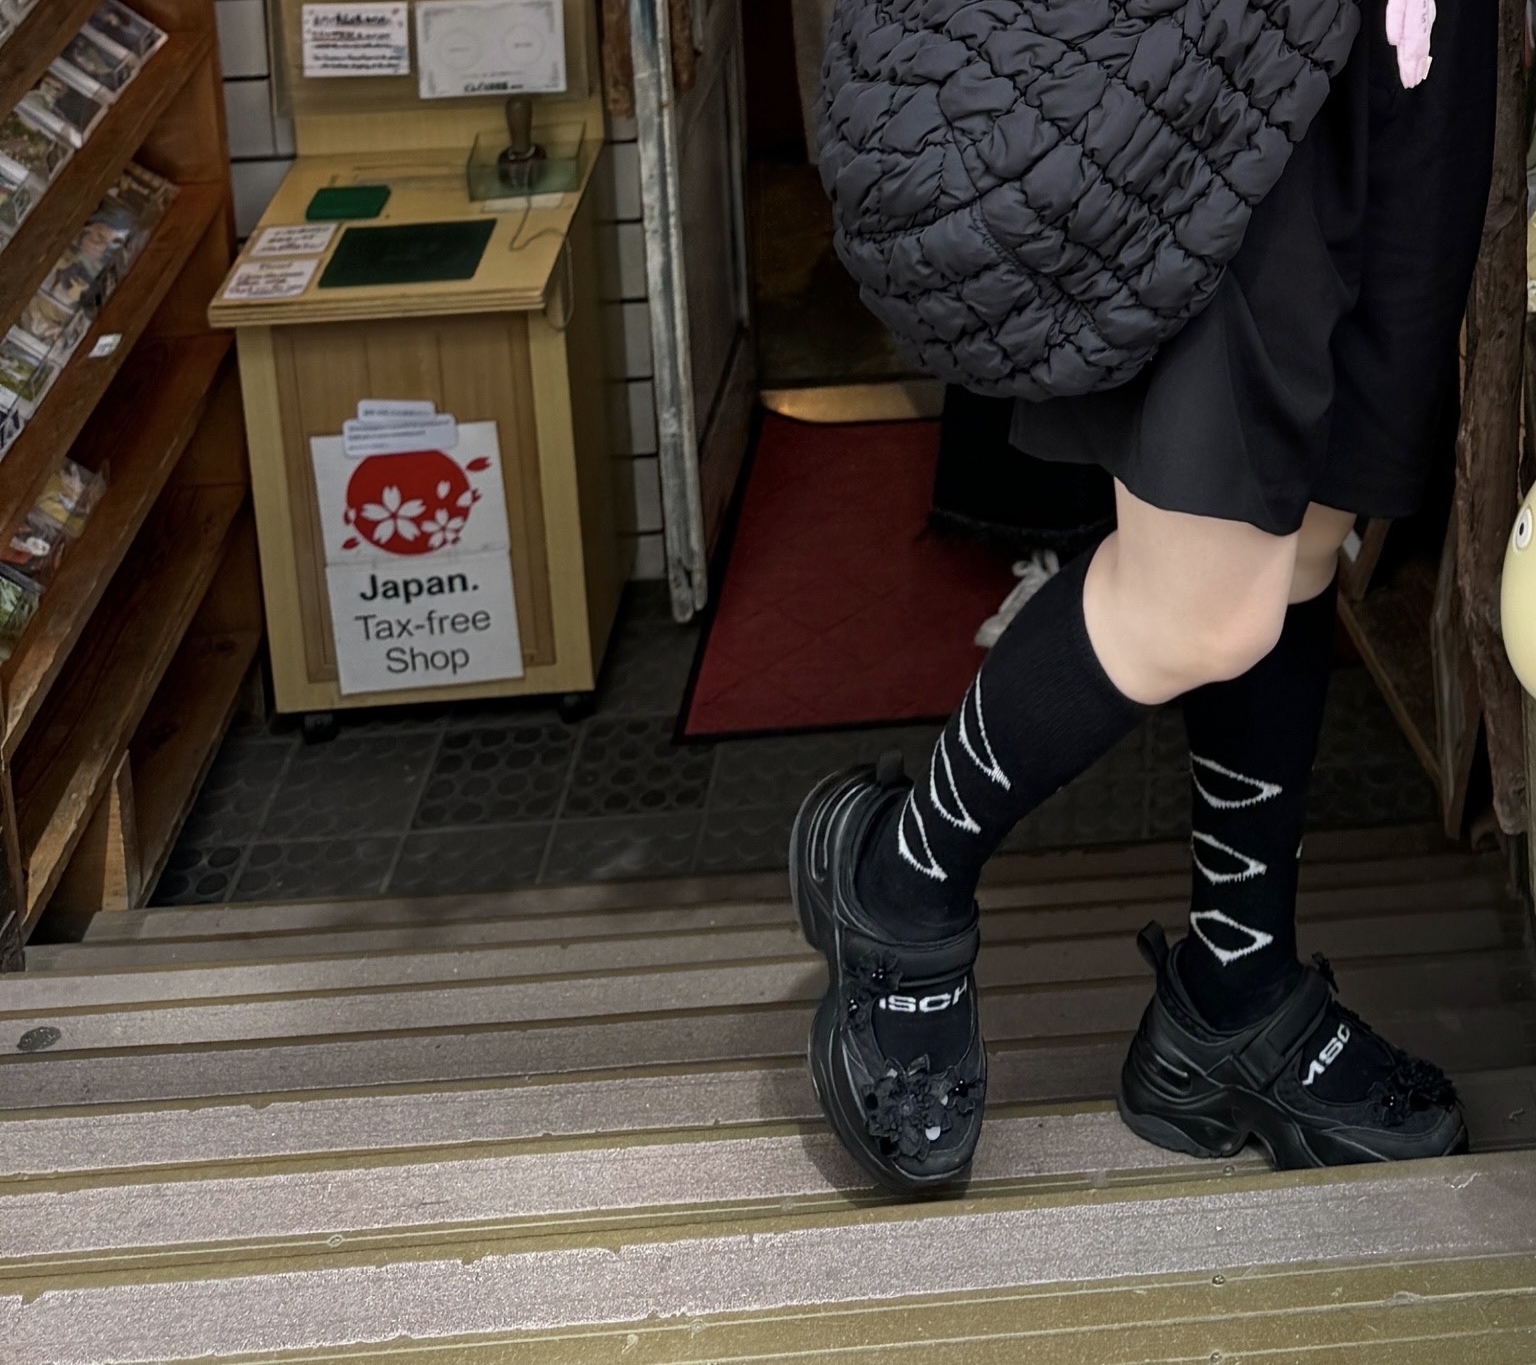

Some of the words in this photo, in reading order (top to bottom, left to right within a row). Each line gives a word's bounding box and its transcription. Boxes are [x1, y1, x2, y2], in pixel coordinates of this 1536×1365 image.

[360, 571, 479, 604] Japan.
[355, 609, 491, 642] Tax-free
[386, 645, 470, 675] Shop
